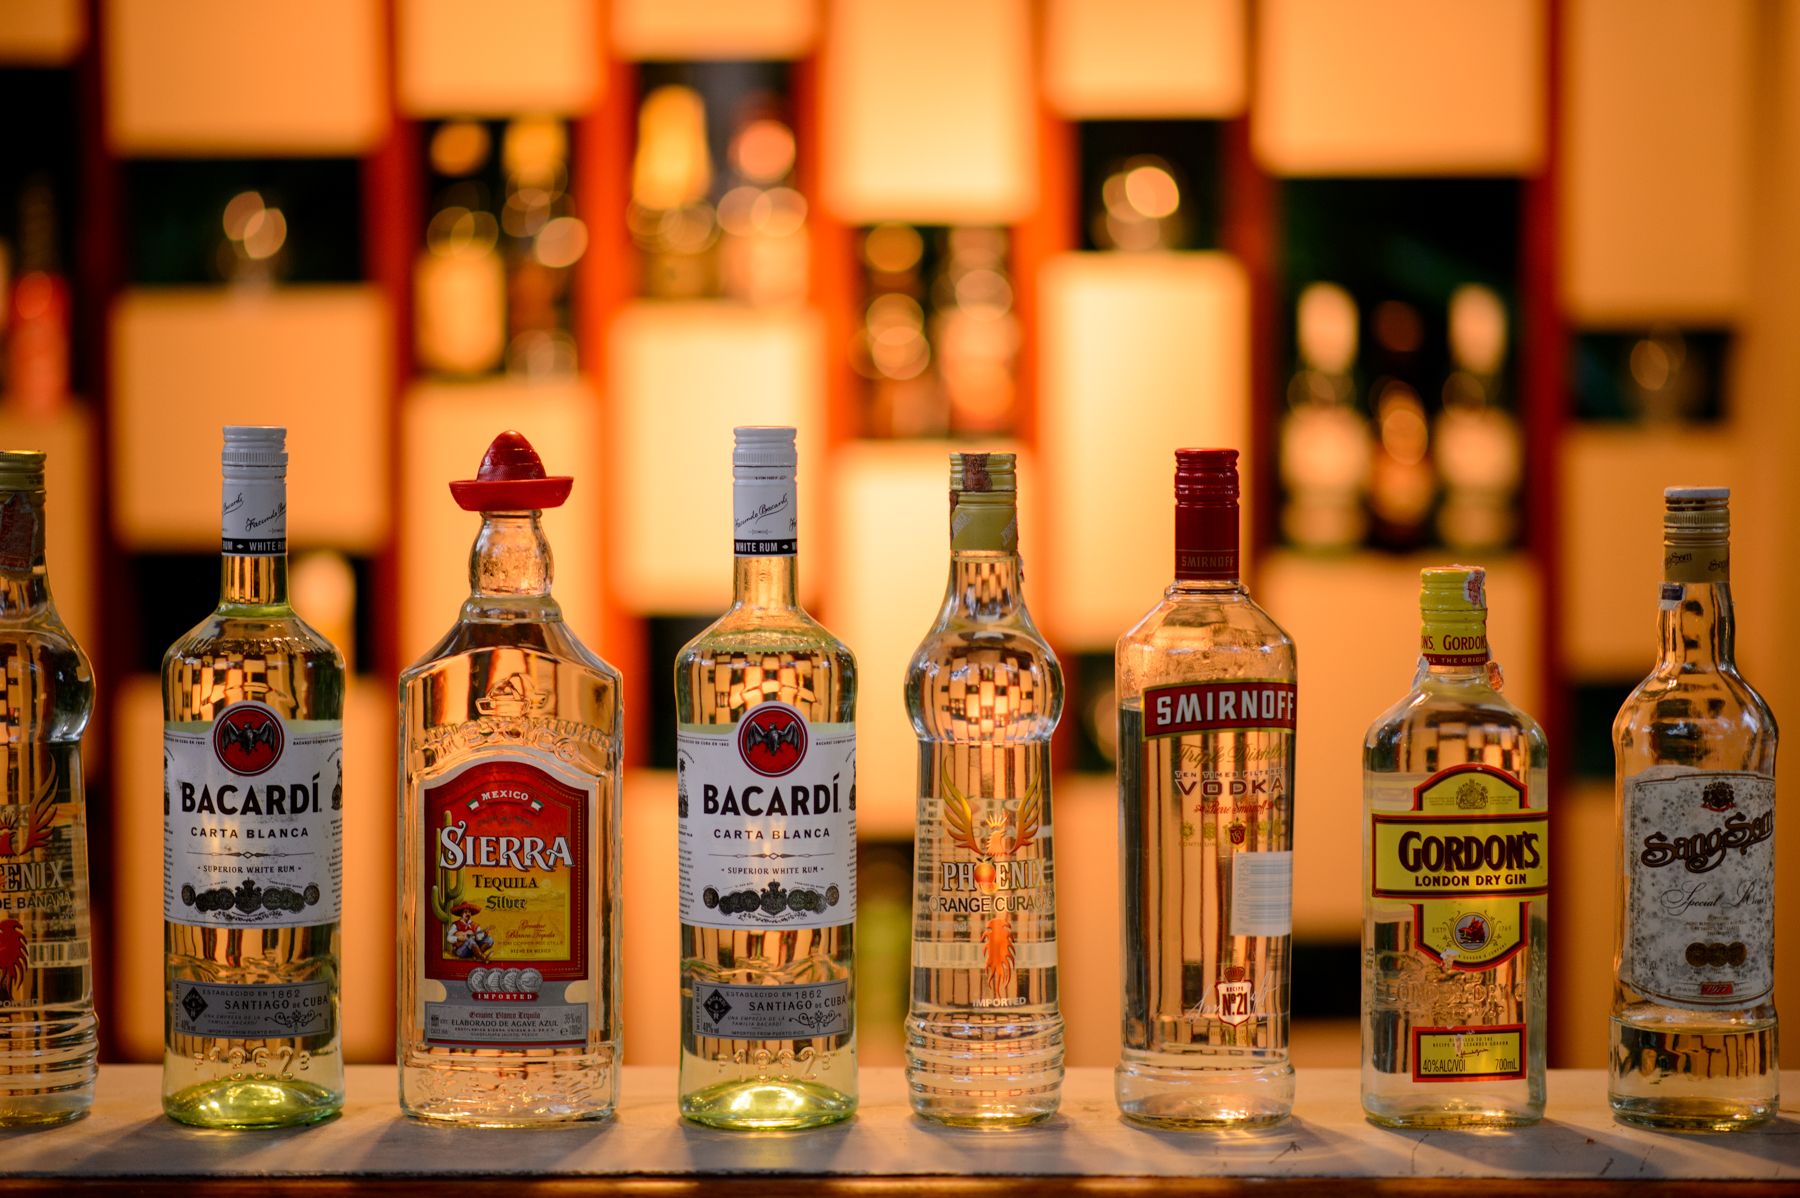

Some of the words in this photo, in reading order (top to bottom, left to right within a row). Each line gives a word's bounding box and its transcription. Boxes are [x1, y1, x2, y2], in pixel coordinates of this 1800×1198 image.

[249, 541, 276, 551] WHITE
[759, 542, 777, 552] RUM
[1181, 556, 1234, 567] SMIRNOFF
[1442, 656, 1458, 664] THE
[1156, 690, 1294, 726] SMIRNOFF
[1203, 770, 1238, 778] TIMES
[1176, 776, 1284, 797] VODKA
[481, 789, 529, 801] MEXICO
[190, 826, 238, 839] CARTA
[246, 827, 309, 839] BLANCA
[713, 828, 765, 840] CARTA
[771, 827, 830, 840] BLANCA
[439, 820, 575, 872] SIERRA
[1398, 830, 1541, 874] GORDON'S
[203, 865, 243, 874] SUPERIOR
[246, 866, 276, 874] WHITE
[277, 865, 295, 873] RUM
[727, 866, 770, 875] SUPERIOR
[771, 866, 801, 875] WHITE
[802, 866, 818, 874] RUM
[472, 874, 539, 892] TEQUILA
[1415, 874, 1470, 887] LONDON
[1475, 874, 1502, 886] DRY
[1504, 873, 1527, 885] GIN
[485, 895, 528, 912] Silver
[929, 896, 991, 913] ORANGE
[1660, 880, 1726, 917] Special
[270, 989, 301, 999] 1862
[725, 990, 779, 998] ESTABLECIDO
[795, 989, 822, 1000] 1862
[224, 1000, 290, 1010] SANTIAGO
[302, 995, 329, 1008] CUBA
[749, 1000, 813, 1012] SANTIAGO
[824, 995, 847, 1008] CUBA
[972, 996, 1027, 1008] IMPORTED
[451, 1019, 499, 1027] ELABORADO
[510, 1020, 537, 1028] AGAVE
[1495, 1058, 1518, 1071] 700mL
